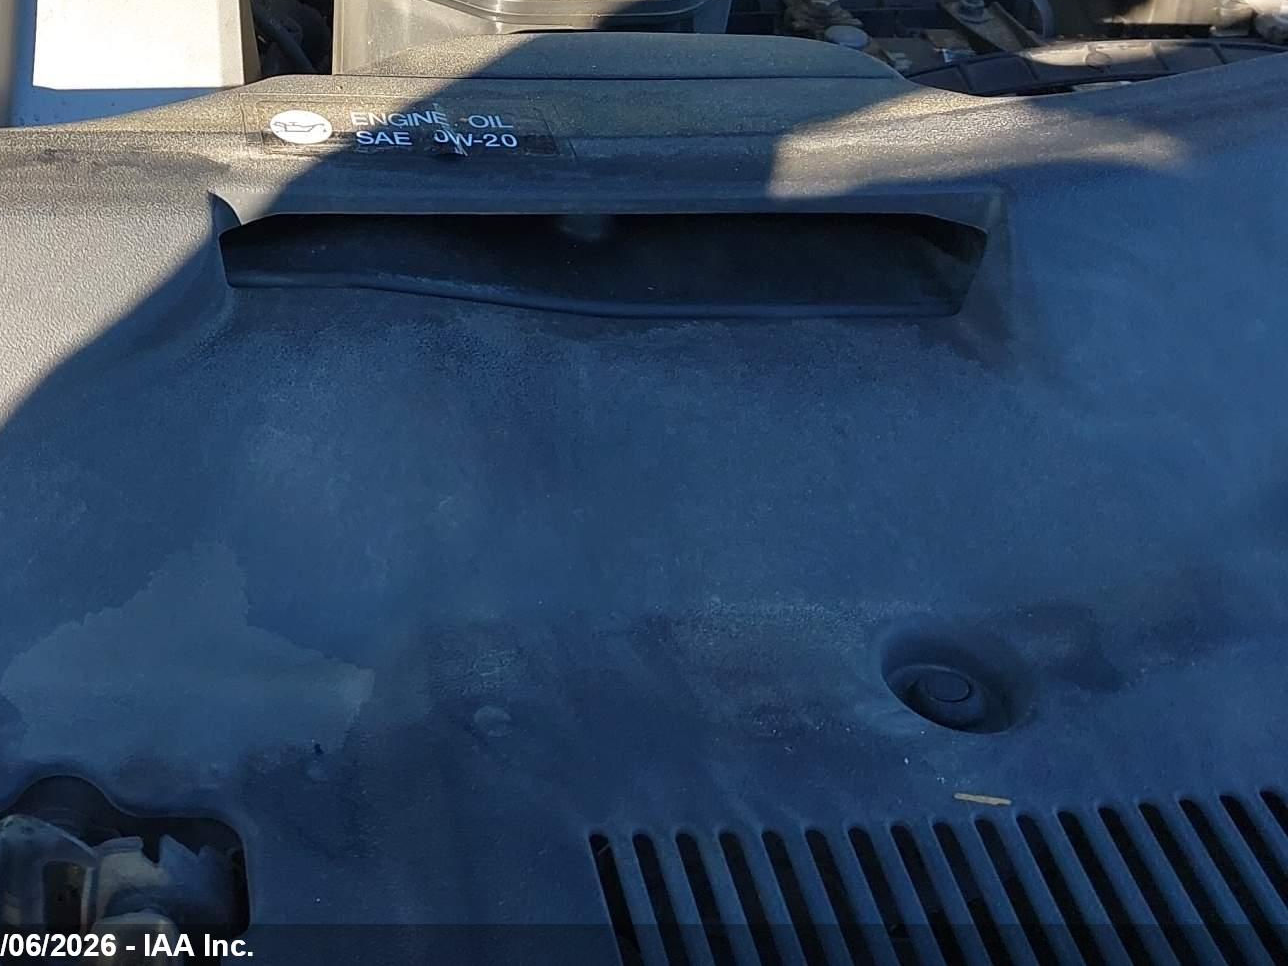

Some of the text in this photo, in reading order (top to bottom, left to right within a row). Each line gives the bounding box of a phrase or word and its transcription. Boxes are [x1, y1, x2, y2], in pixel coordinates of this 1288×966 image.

[350, 110, 514, 129] ENGINE OIL
[356, 130, 518, 148] SAE 0W-20
